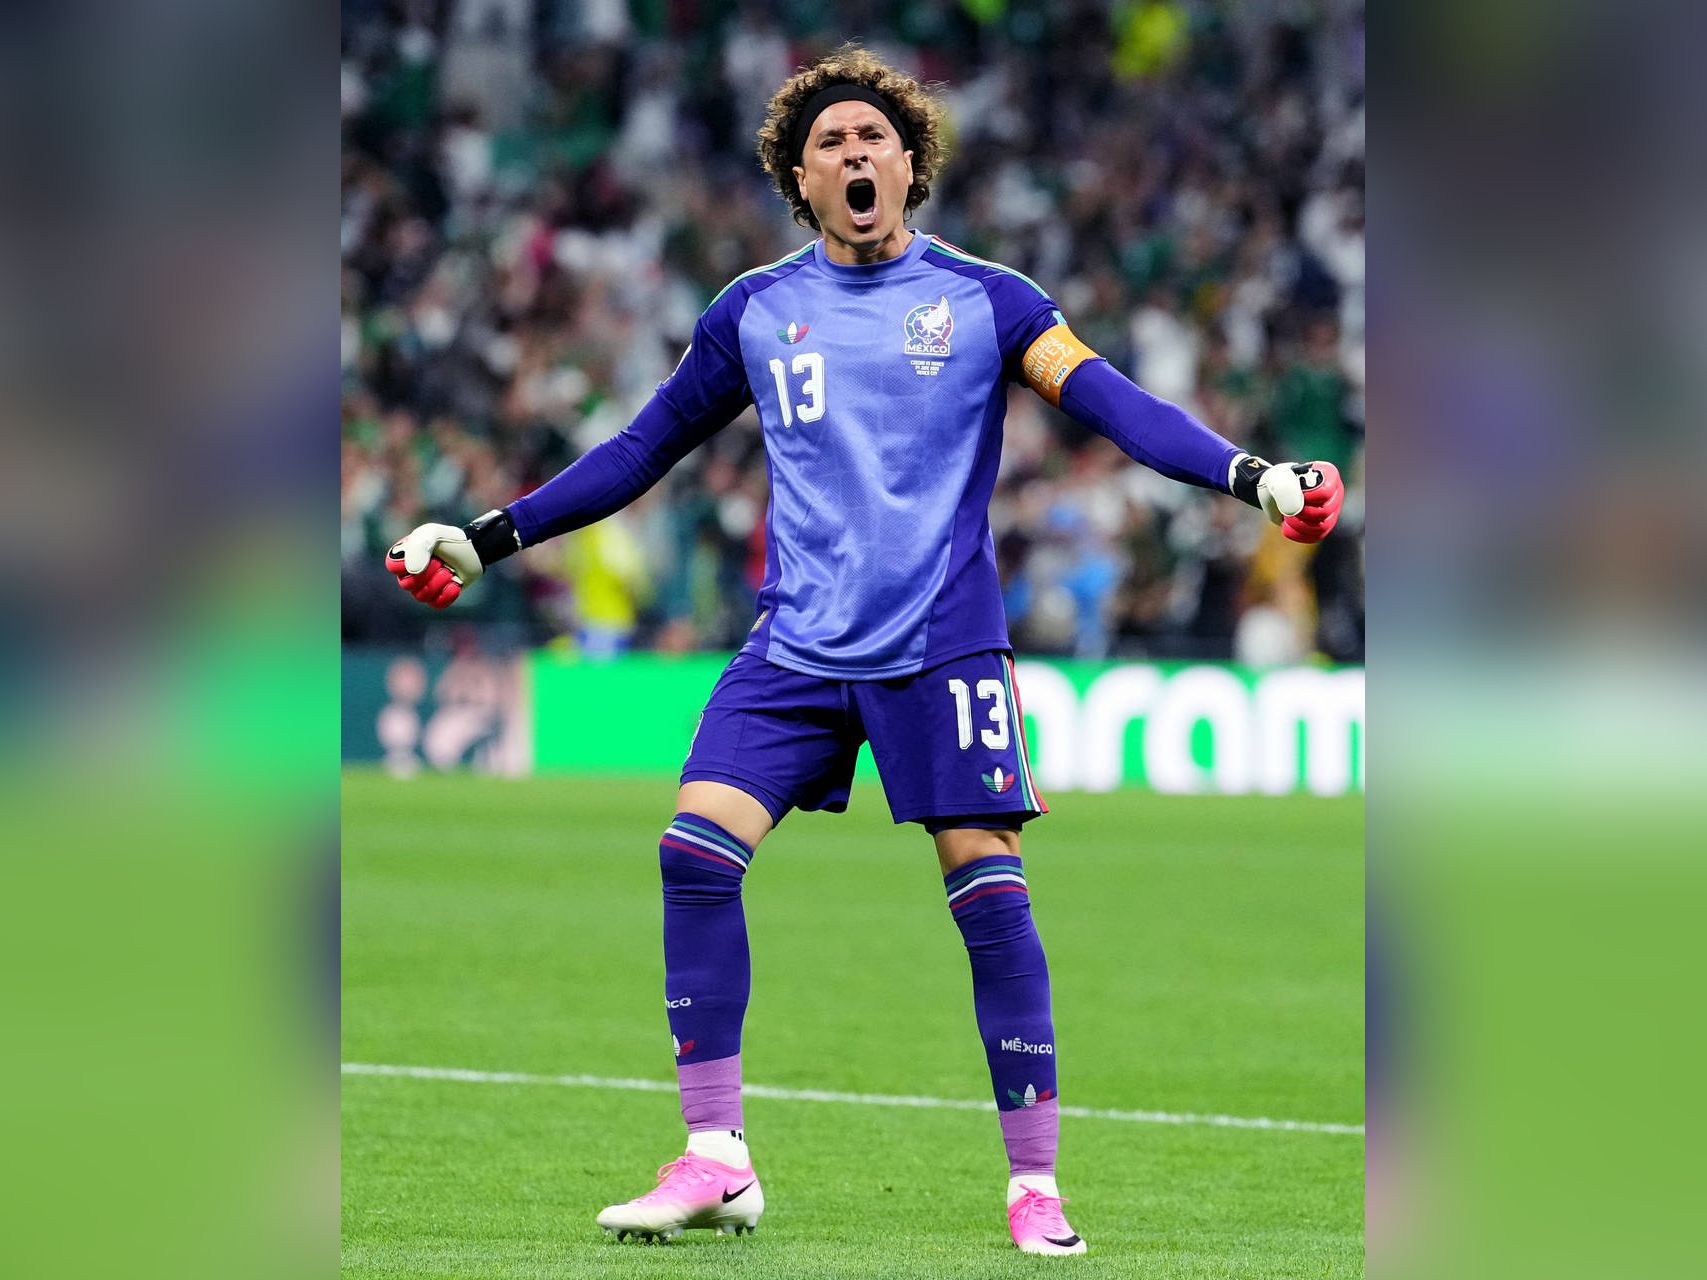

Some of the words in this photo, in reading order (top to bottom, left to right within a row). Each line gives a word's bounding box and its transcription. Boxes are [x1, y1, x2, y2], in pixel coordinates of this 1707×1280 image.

[907, 342, 947, 353] MÉXICO
[1024, 335, 1056, 374] FOOTBALL
[1031, 341, 1065, 381] UNITES
[769, 352, 826, 428] 13
[1054, 367, 1068, 385] FIFA
[948, 679, 1009, 750] 13
[1001, 1037, 1053, 1055] MÉXICO
